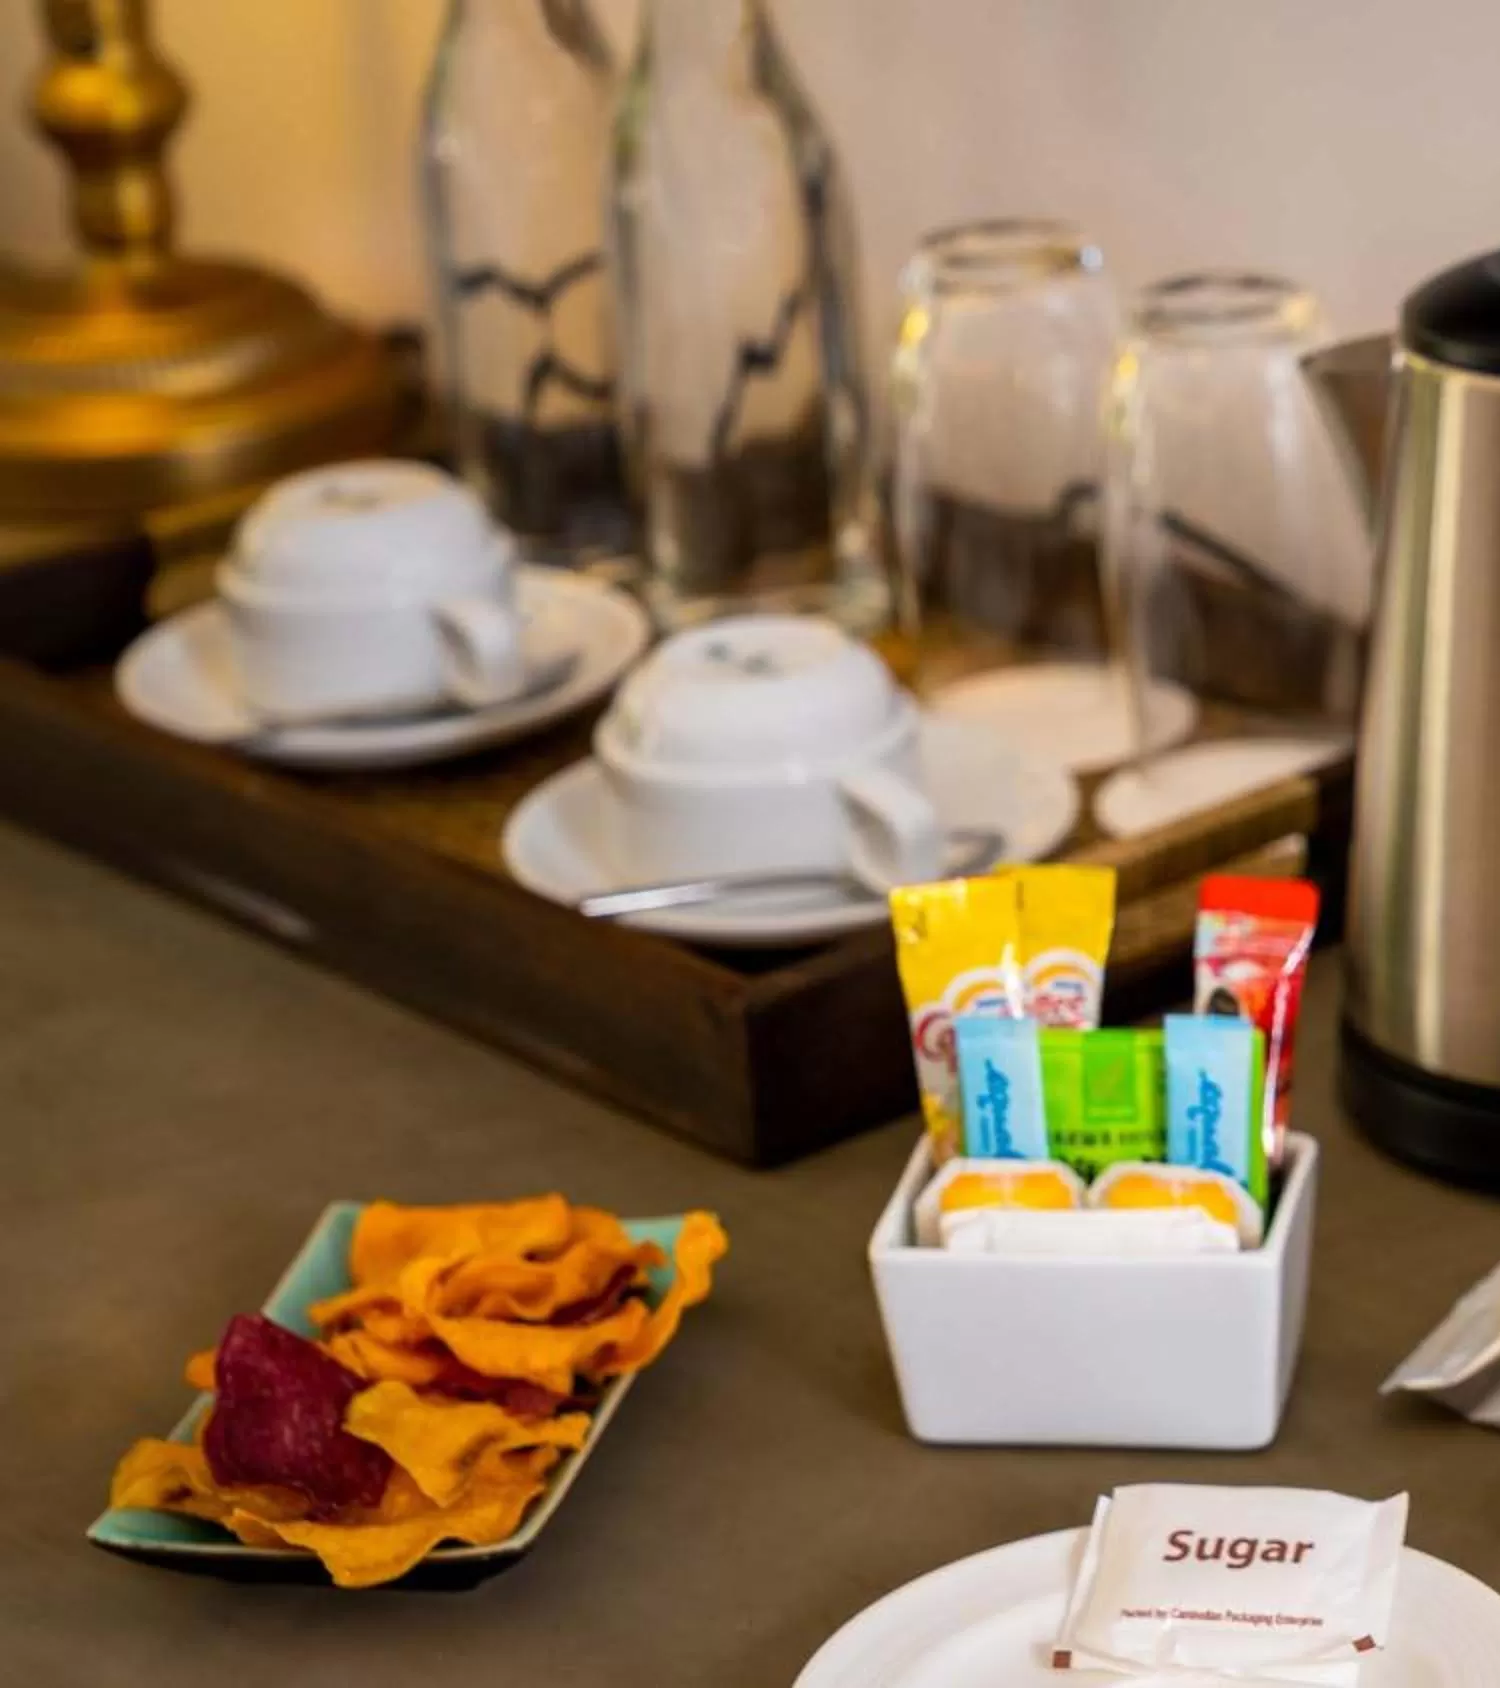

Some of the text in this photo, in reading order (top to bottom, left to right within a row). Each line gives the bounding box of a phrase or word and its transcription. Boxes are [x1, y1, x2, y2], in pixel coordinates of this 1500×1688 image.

[1163, 1529, 1314, 1569] Sugar
[1226, 1609, 1272, 1626] Packaging
[1275, 1612, 1323, 1627] Enterprise
